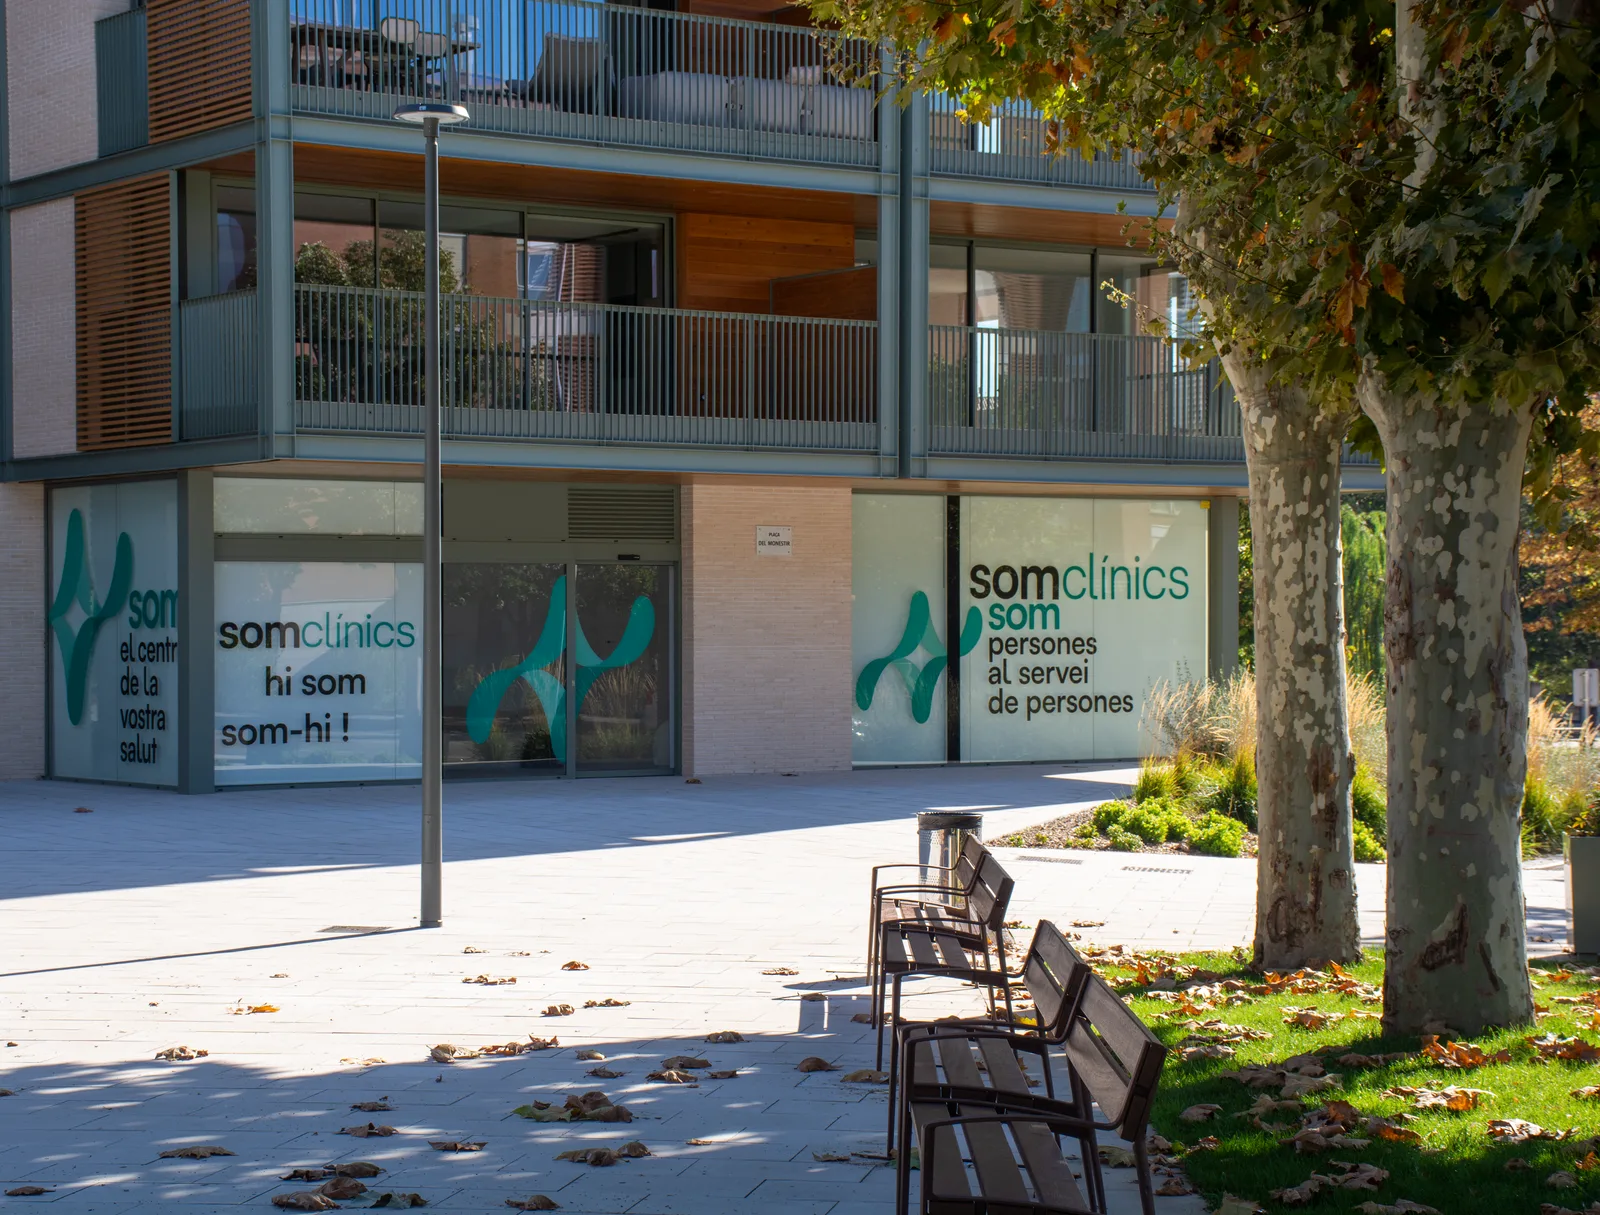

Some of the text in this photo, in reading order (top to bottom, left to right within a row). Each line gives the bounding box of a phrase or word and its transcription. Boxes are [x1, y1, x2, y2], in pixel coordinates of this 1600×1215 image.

[969, 552, 1190, 600] somclínics
[219, 612, 416, 649] somclínics
[987, 602, 1061, 631] som
[120, 632, 136, 663] el
[988, 636, 1098, 662] persones
[120, 666, 159, 696] de la
[265, 666, 366, 696] hi som
[987, 658, 1089, 685] al servei
[120, 703, 166, 731] vostra
[987, 688, 1134, 721] de persones
[221, 711, 350, 746] som-hi !
[120, 732, 158, 764] salut
